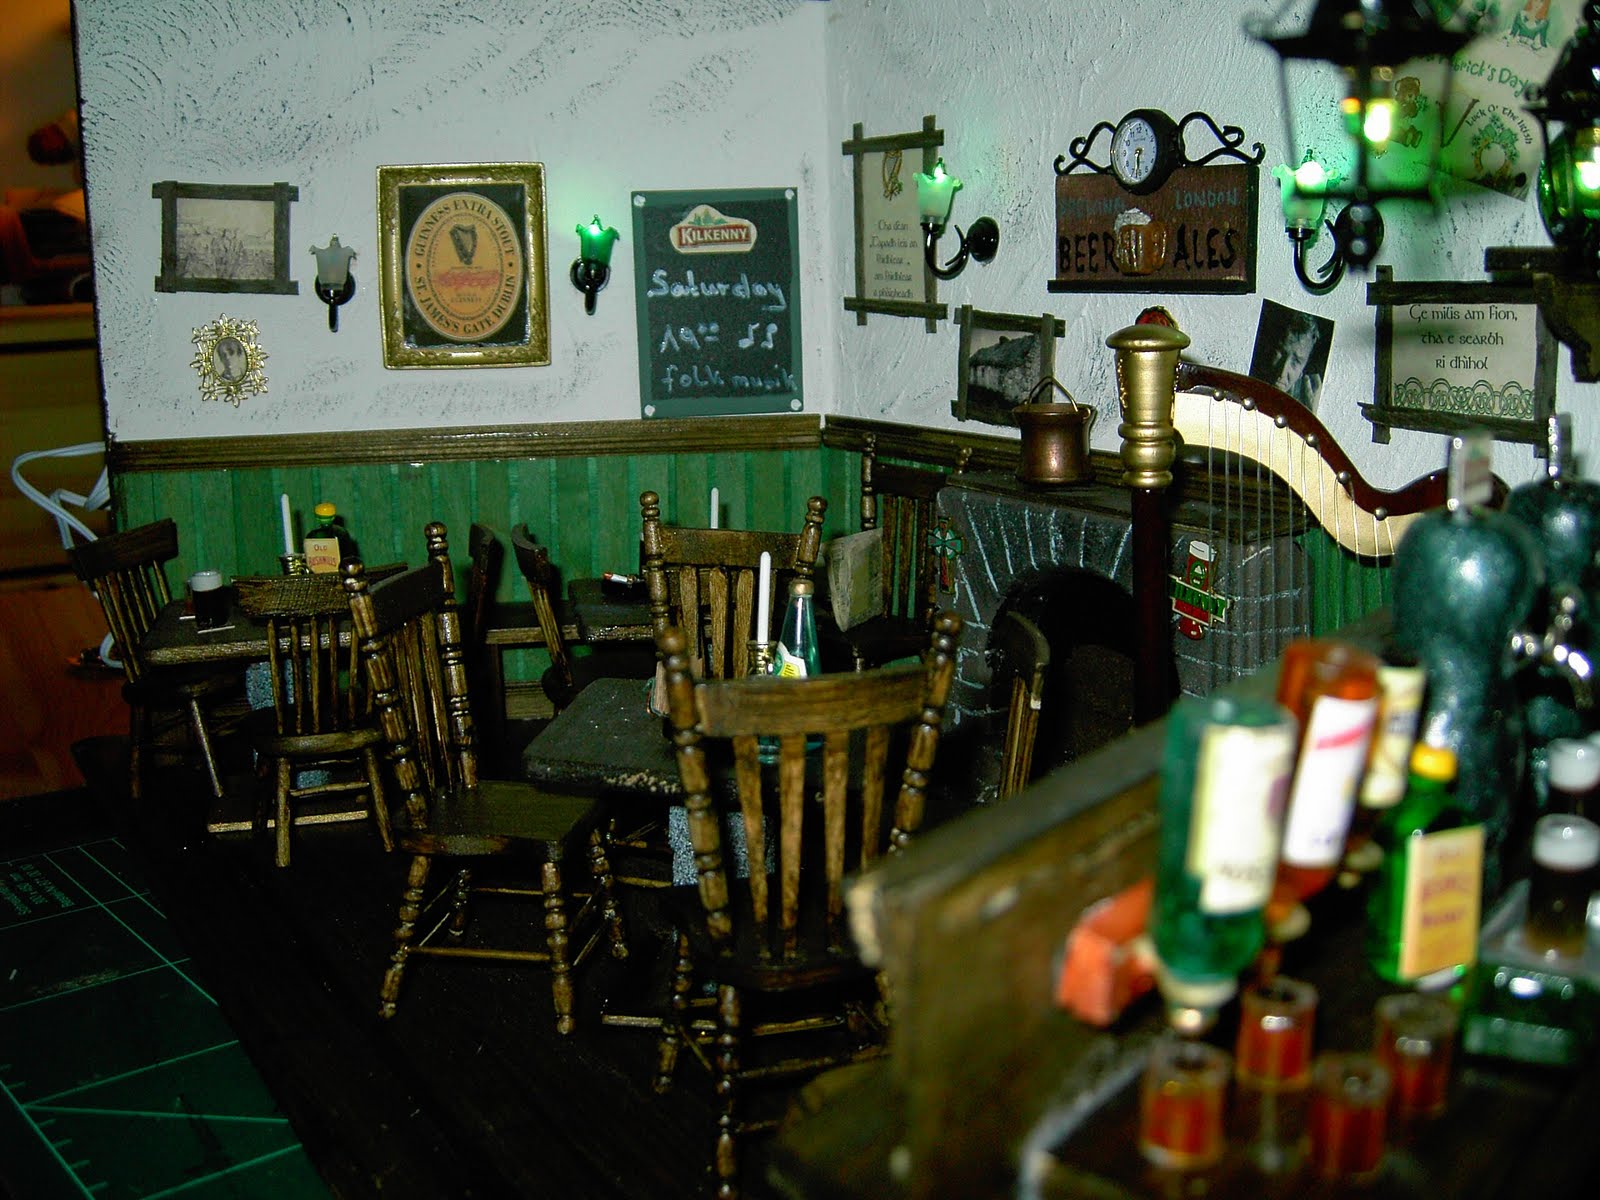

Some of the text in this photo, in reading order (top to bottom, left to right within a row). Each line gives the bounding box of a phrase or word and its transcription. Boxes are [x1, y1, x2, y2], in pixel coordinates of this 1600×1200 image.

[1499, 67, 1529, 98] Day
[1465, 108, 1487, 127] Luck
[1517, 119, 1533, 145] Irish
[415, 199, 515, 257] GUINNESS EXTRA STOUT
[681, 226, 748, 244] KILKENNY
[1059, 223, 1240, 273] BEER ALES
[463, 317, 496, 334] GATE
[494, 273, 515, 319] DUBLIN
[647, 268, 787, 312] Saturday
[1431, 306, 1460, 320] milis
[1464, 309, 1485, 320] am
[1421, 331, 1444, 345] tha
[661, 364, 725, 393] folk
